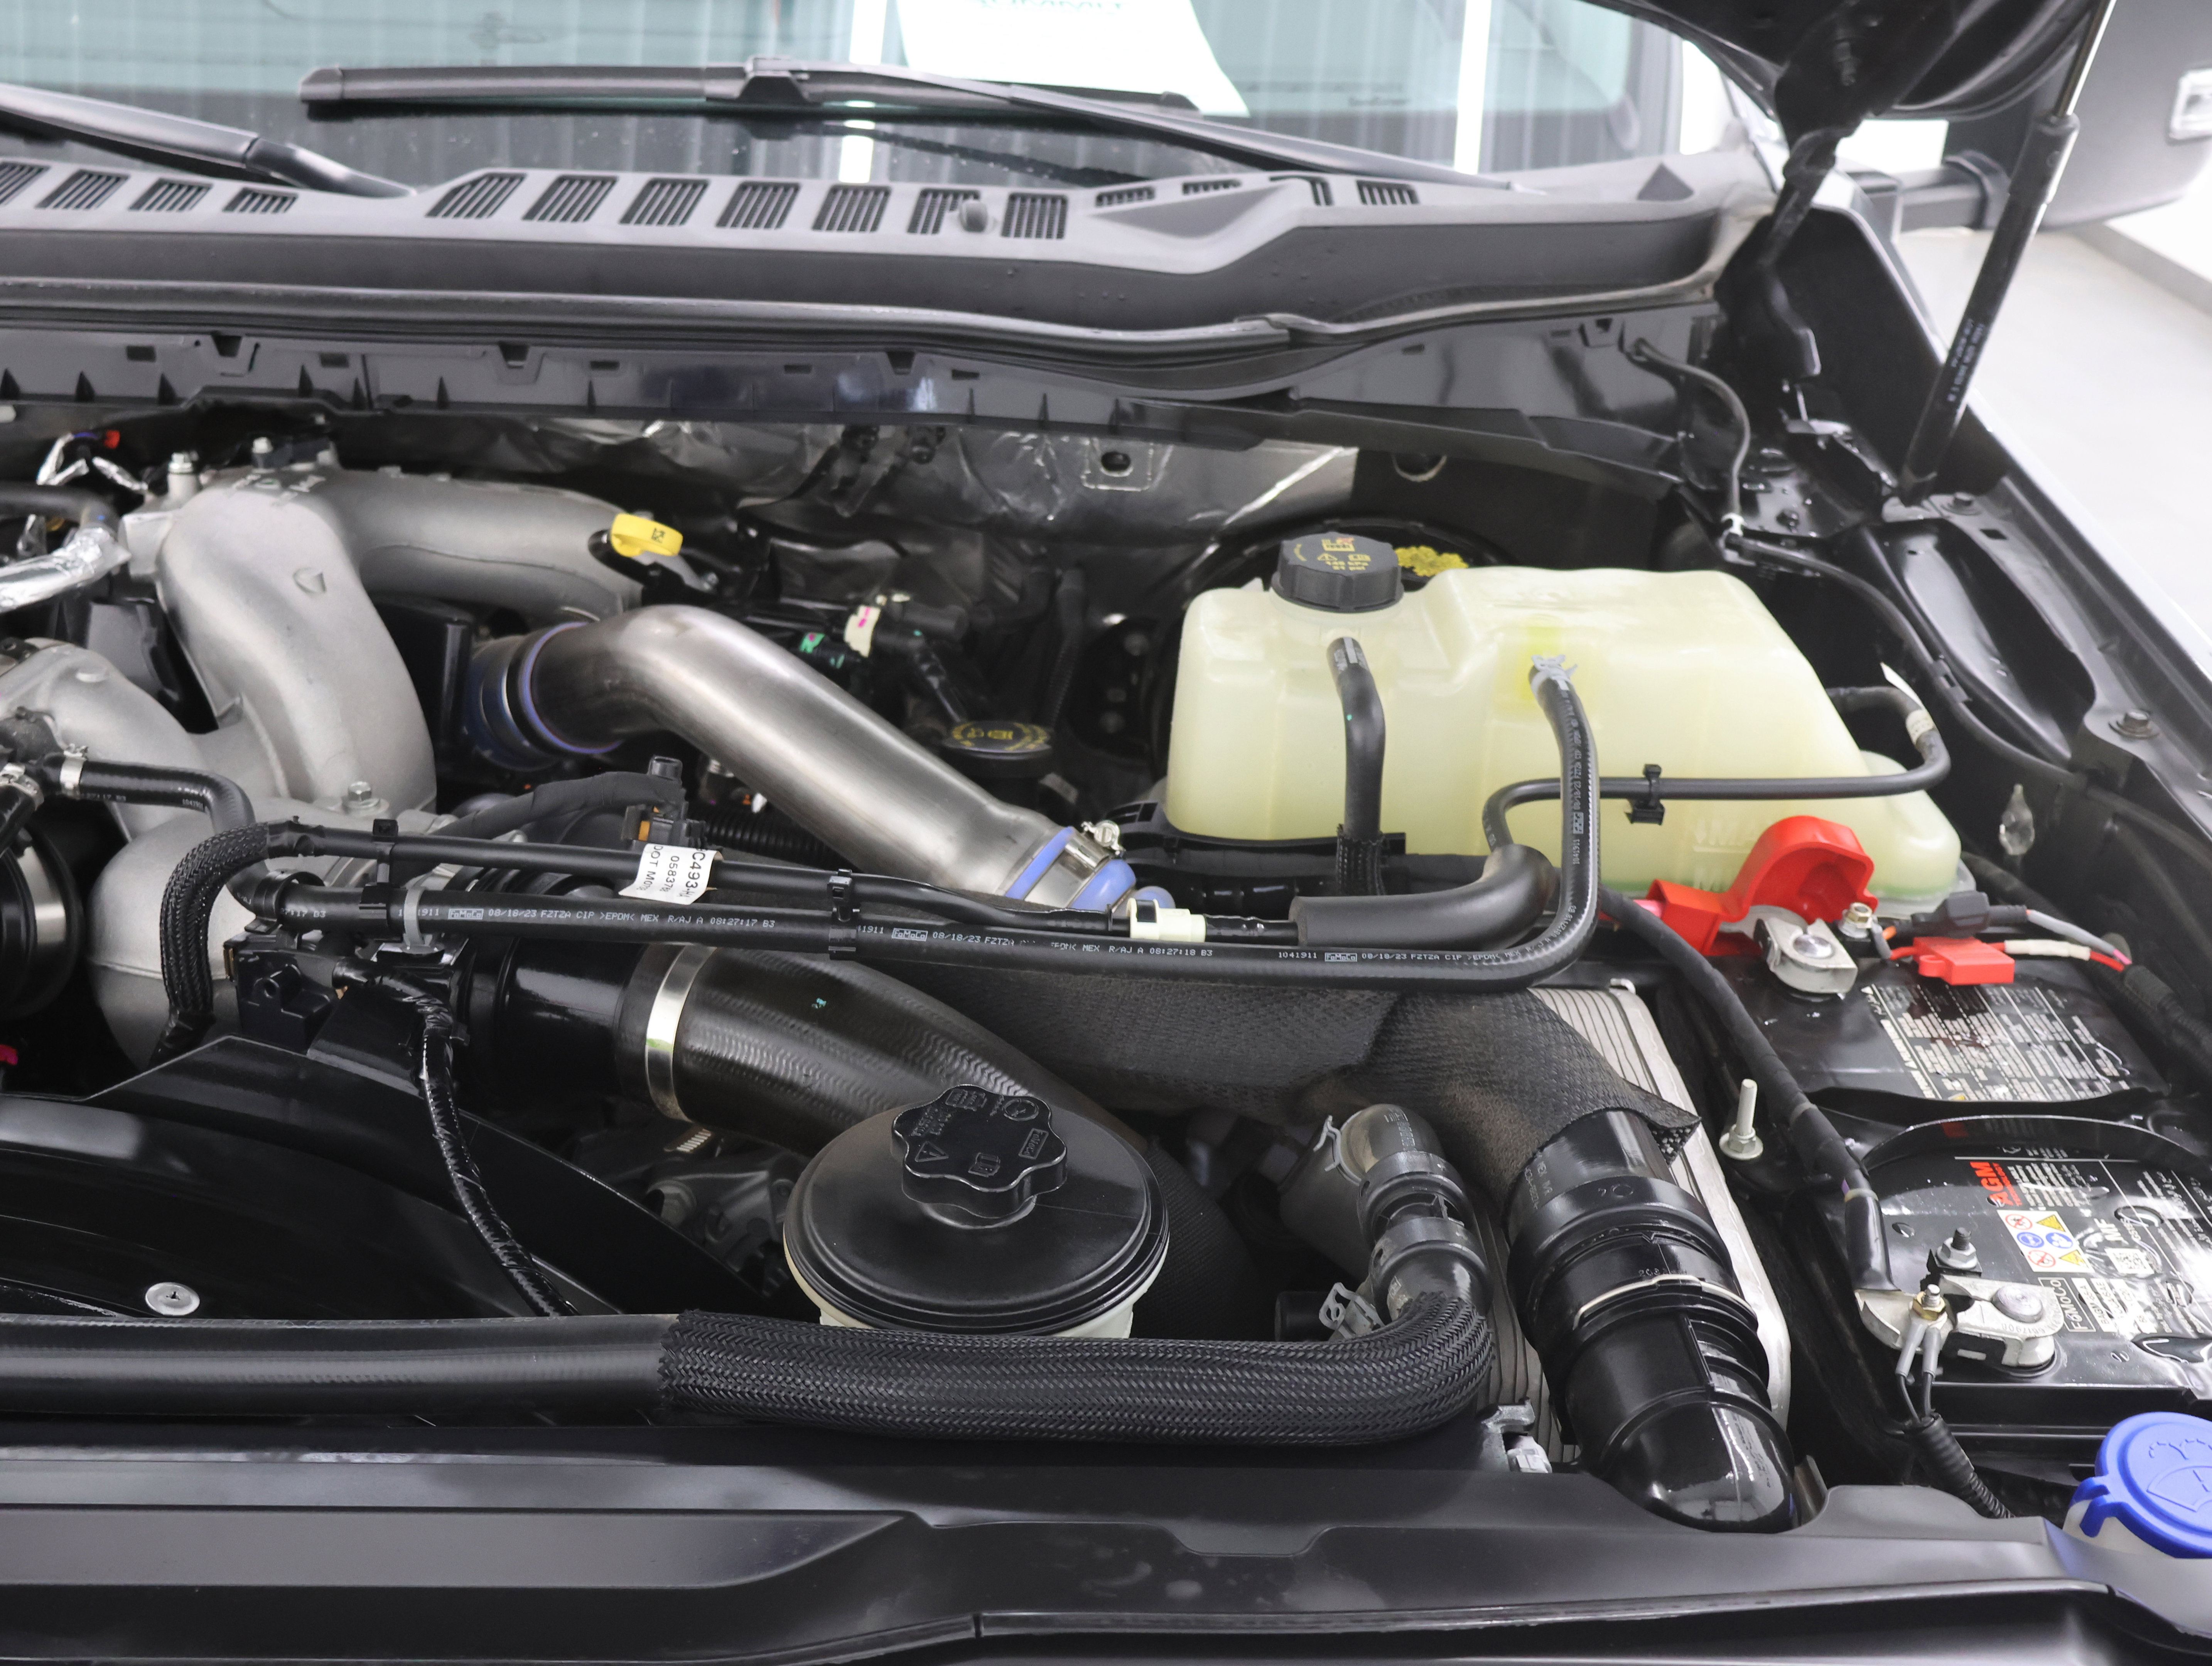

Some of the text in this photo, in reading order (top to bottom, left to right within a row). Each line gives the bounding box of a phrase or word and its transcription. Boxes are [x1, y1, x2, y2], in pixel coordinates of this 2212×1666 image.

[649, 846, 663, 867] DOT
[449, 909, 483, 919] FoMoCo
[488, 909, 537, 917] 08/18/23
[576, 911, 595, 919] CIP
[641, 914, 659, 922] MEX
[710, 917, 758, 927] 08:27:17
[892, 928, 928, 941] FoMoCo
[933, 931, 982, 943] 08/18/23
[1082, 944, 1100, 953] MEX
[1325, 952, 1358, 962] FoMoCo
[1970, 1162, 2014, 1206] AGM
